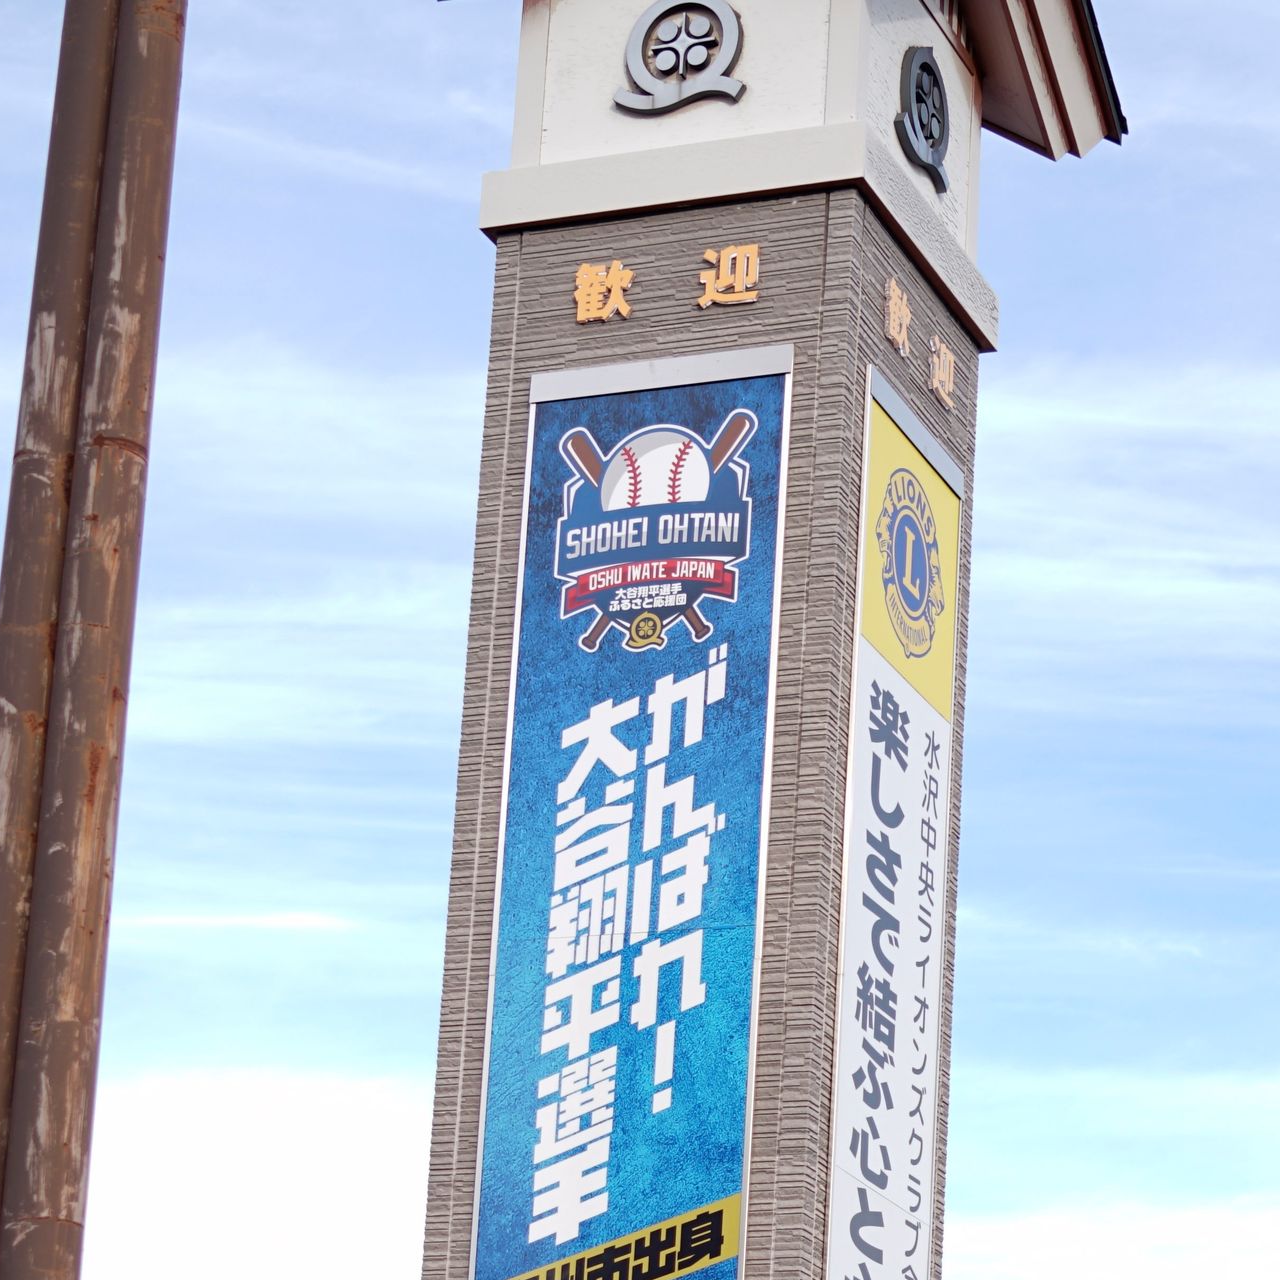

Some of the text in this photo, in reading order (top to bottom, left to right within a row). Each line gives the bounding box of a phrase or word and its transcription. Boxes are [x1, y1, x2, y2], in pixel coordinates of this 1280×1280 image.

[573, 243, 761, 324] 歓迎
[894, 476, 933, 537] LIONS
[566, 513, 740, 559] SHOHEI OHTANI
[589, 560, 715, 590] OSHU IWATE JAPAN
[615, 582, 682, 600] 大谷翔平選手
[609, 594, 687, 612] ふるさと応援団
[889, 592, 928, 646] INTERNATIONAL
[528, 696, 640, 1246] 大谷翔平選手
